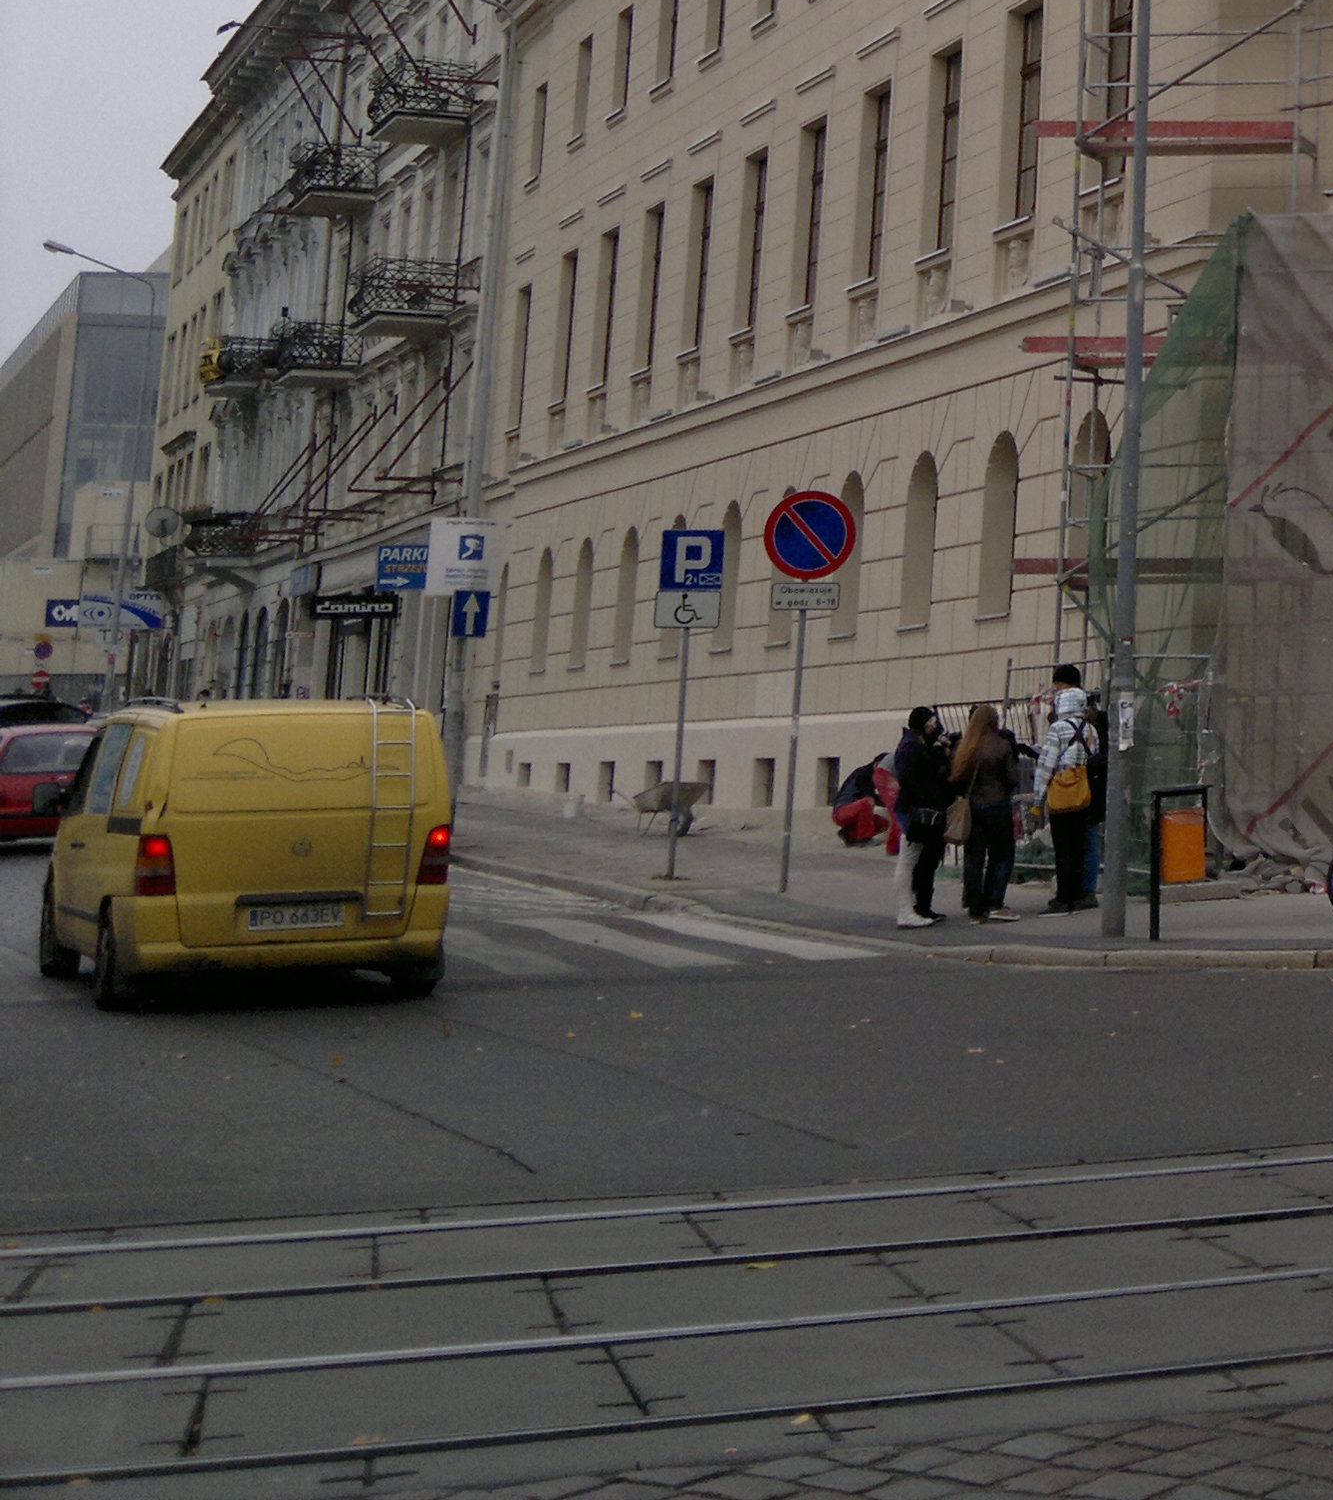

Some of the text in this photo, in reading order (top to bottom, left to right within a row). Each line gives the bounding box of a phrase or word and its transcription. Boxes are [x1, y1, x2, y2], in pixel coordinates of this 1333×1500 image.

[380, 547, 428, 561] PARKI
[674, 536, 712, 583] P
[316, 601, 394, 614] domino
[259, 909, 285, 927] PO
